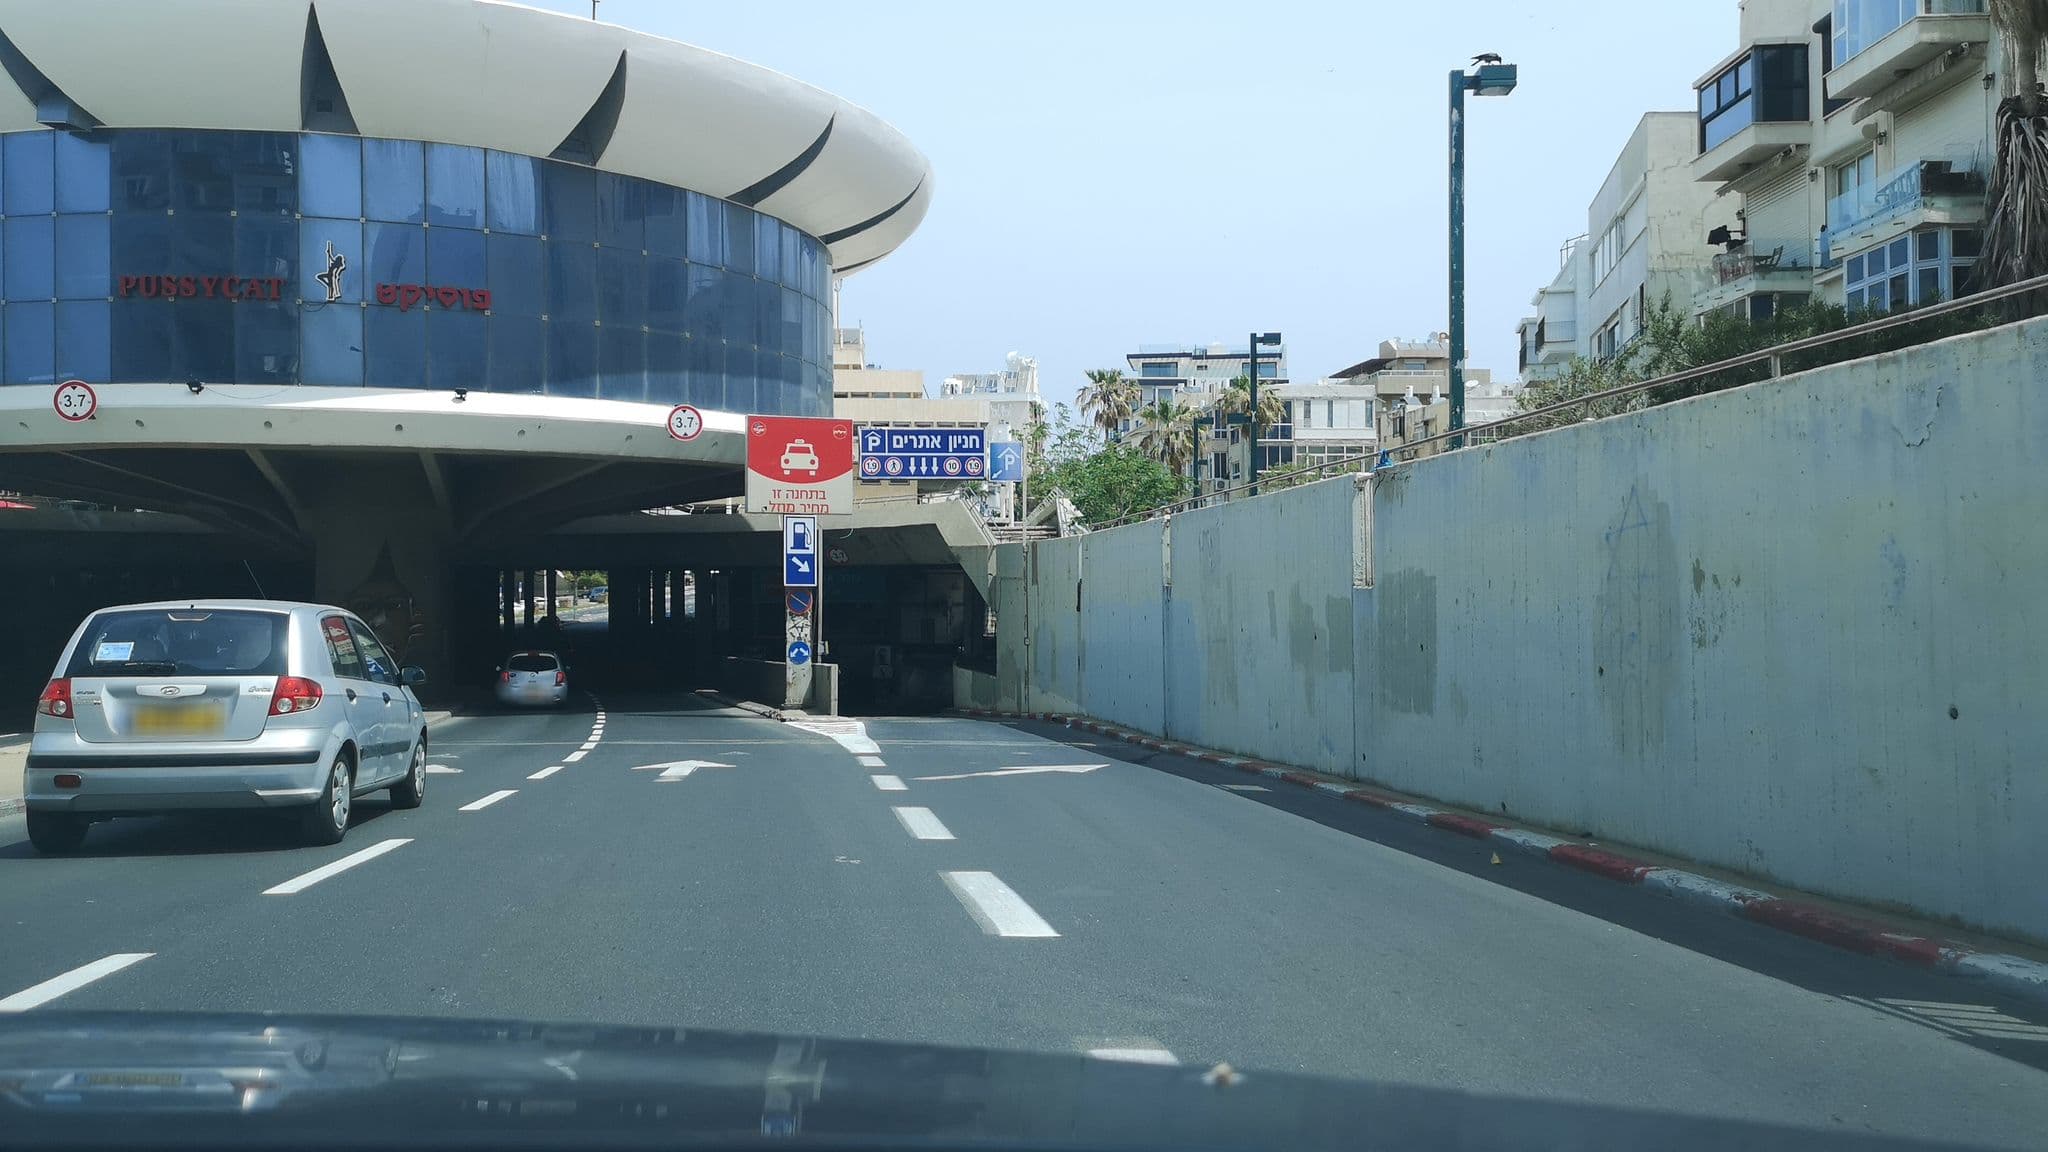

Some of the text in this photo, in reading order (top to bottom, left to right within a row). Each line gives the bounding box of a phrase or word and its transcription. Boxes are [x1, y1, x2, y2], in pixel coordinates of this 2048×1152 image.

[118, 275, 285, 299] PUSSYCAT
[376, 283, 491, 312] פוסיקט
[64, 394, 86, 408] 3.7
[675, 416, 694, 428] 3.7
[892, 434, 980, 453] חניון אתרים
[948, 462, 957, 470] 10
[772, 489, 827, 500] בתחנה זו
[799, 503, 830, 513] מחיר
